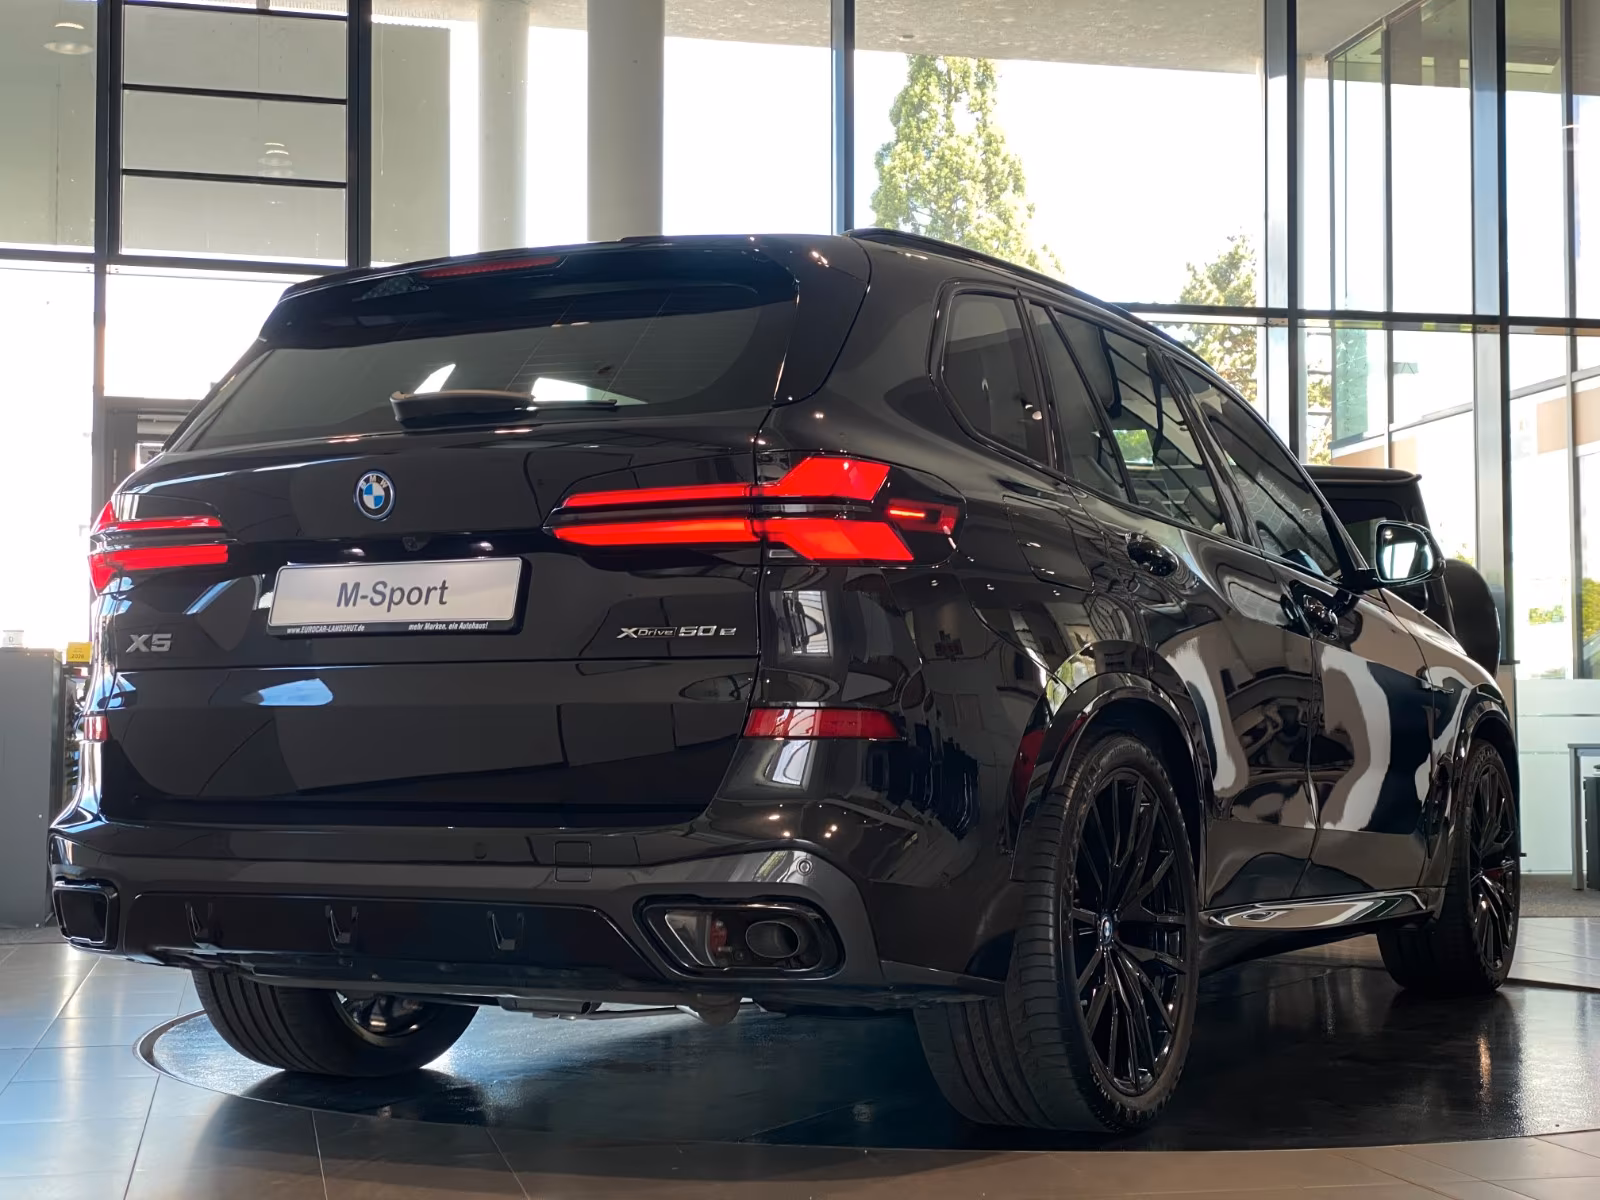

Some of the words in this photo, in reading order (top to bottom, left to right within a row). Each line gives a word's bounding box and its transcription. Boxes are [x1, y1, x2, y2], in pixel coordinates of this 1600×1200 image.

[360, 475, 389, 490] BMW
[336, 579, 449, 613] M-Sport
[408, 623, 423, 631] mehr
[448, 622, 458, 630] ein
[459, 621, 488, 629] Autohaus!
[125, 633, 172, 653] X5
